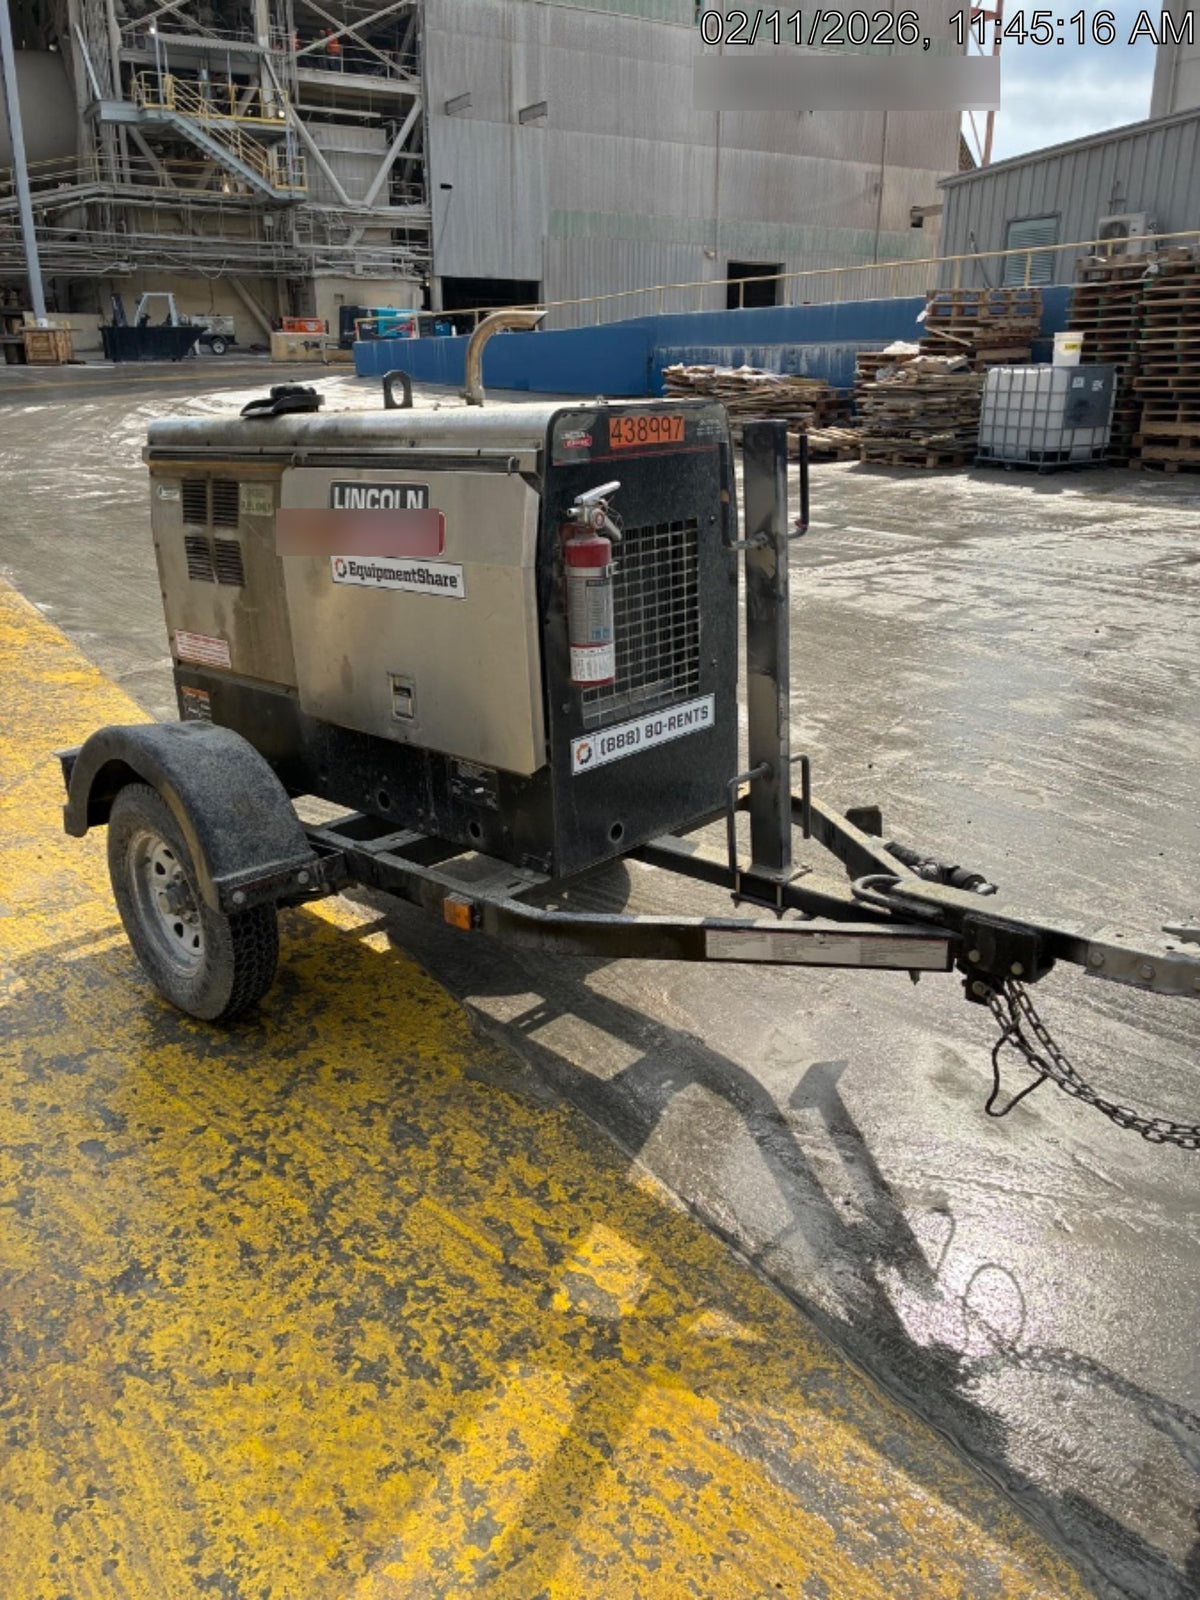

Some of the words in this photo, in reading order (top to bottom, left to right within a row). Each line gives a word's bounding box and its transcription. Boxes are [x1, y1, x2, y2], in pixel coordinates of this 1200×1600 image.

[611, 416, 683, 443] 438997
[348, 561, 458, 589] EquipmentShare
[600, 726, 641, 756] (888)
